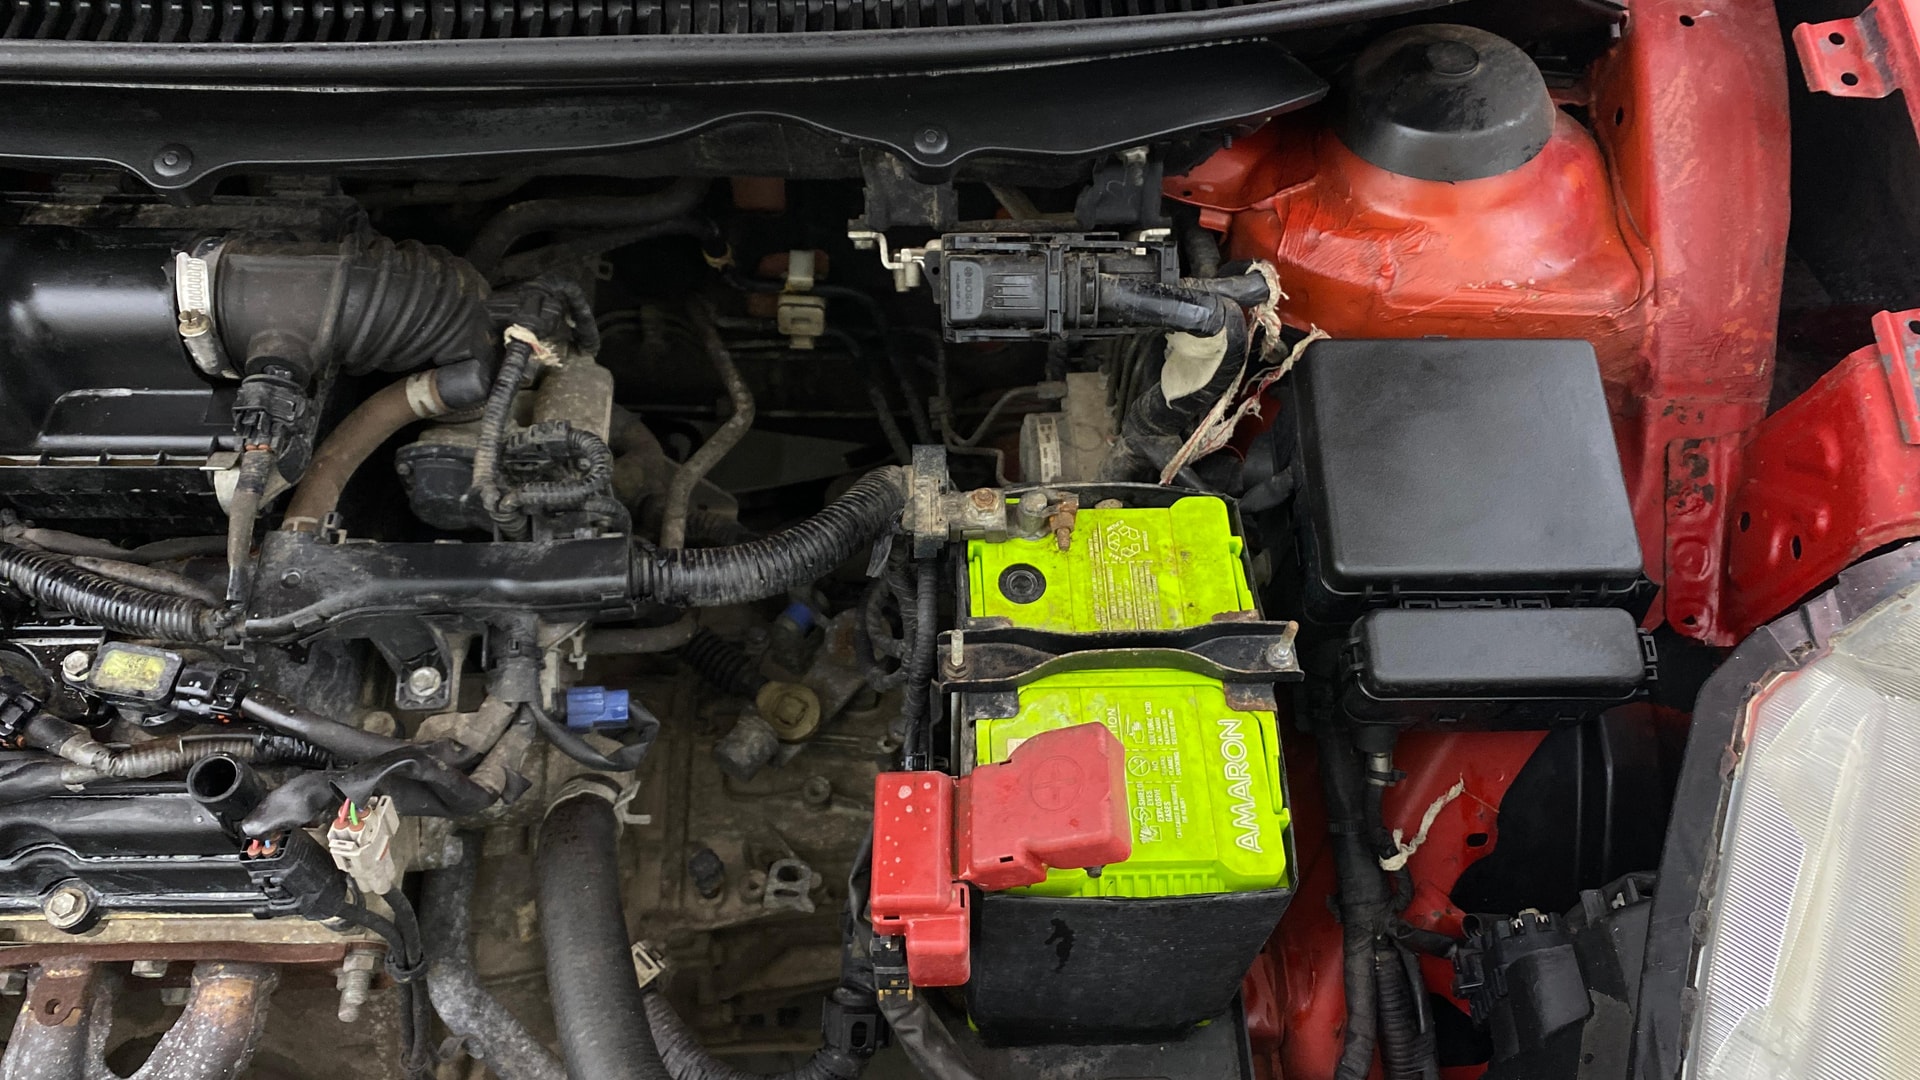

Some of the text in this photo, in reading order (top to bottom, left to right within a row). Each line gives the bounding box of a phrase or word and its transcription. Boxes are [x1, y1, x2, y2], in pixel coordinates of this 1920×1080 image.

[964, 278, 973, 316] BOSCH
[1107, 707, 1118, 734] TION
[1152, 760, 1159, 771] NO
[1135, 782, 1145, 806] SHIELD
[1145, 790, 1154, 806] EYES
[1217, 719, 1263, 853] AMARON
[1154, 788, 1165, 823] EXPLOSIVE
[1163, 801, 1173, 822] GASES
